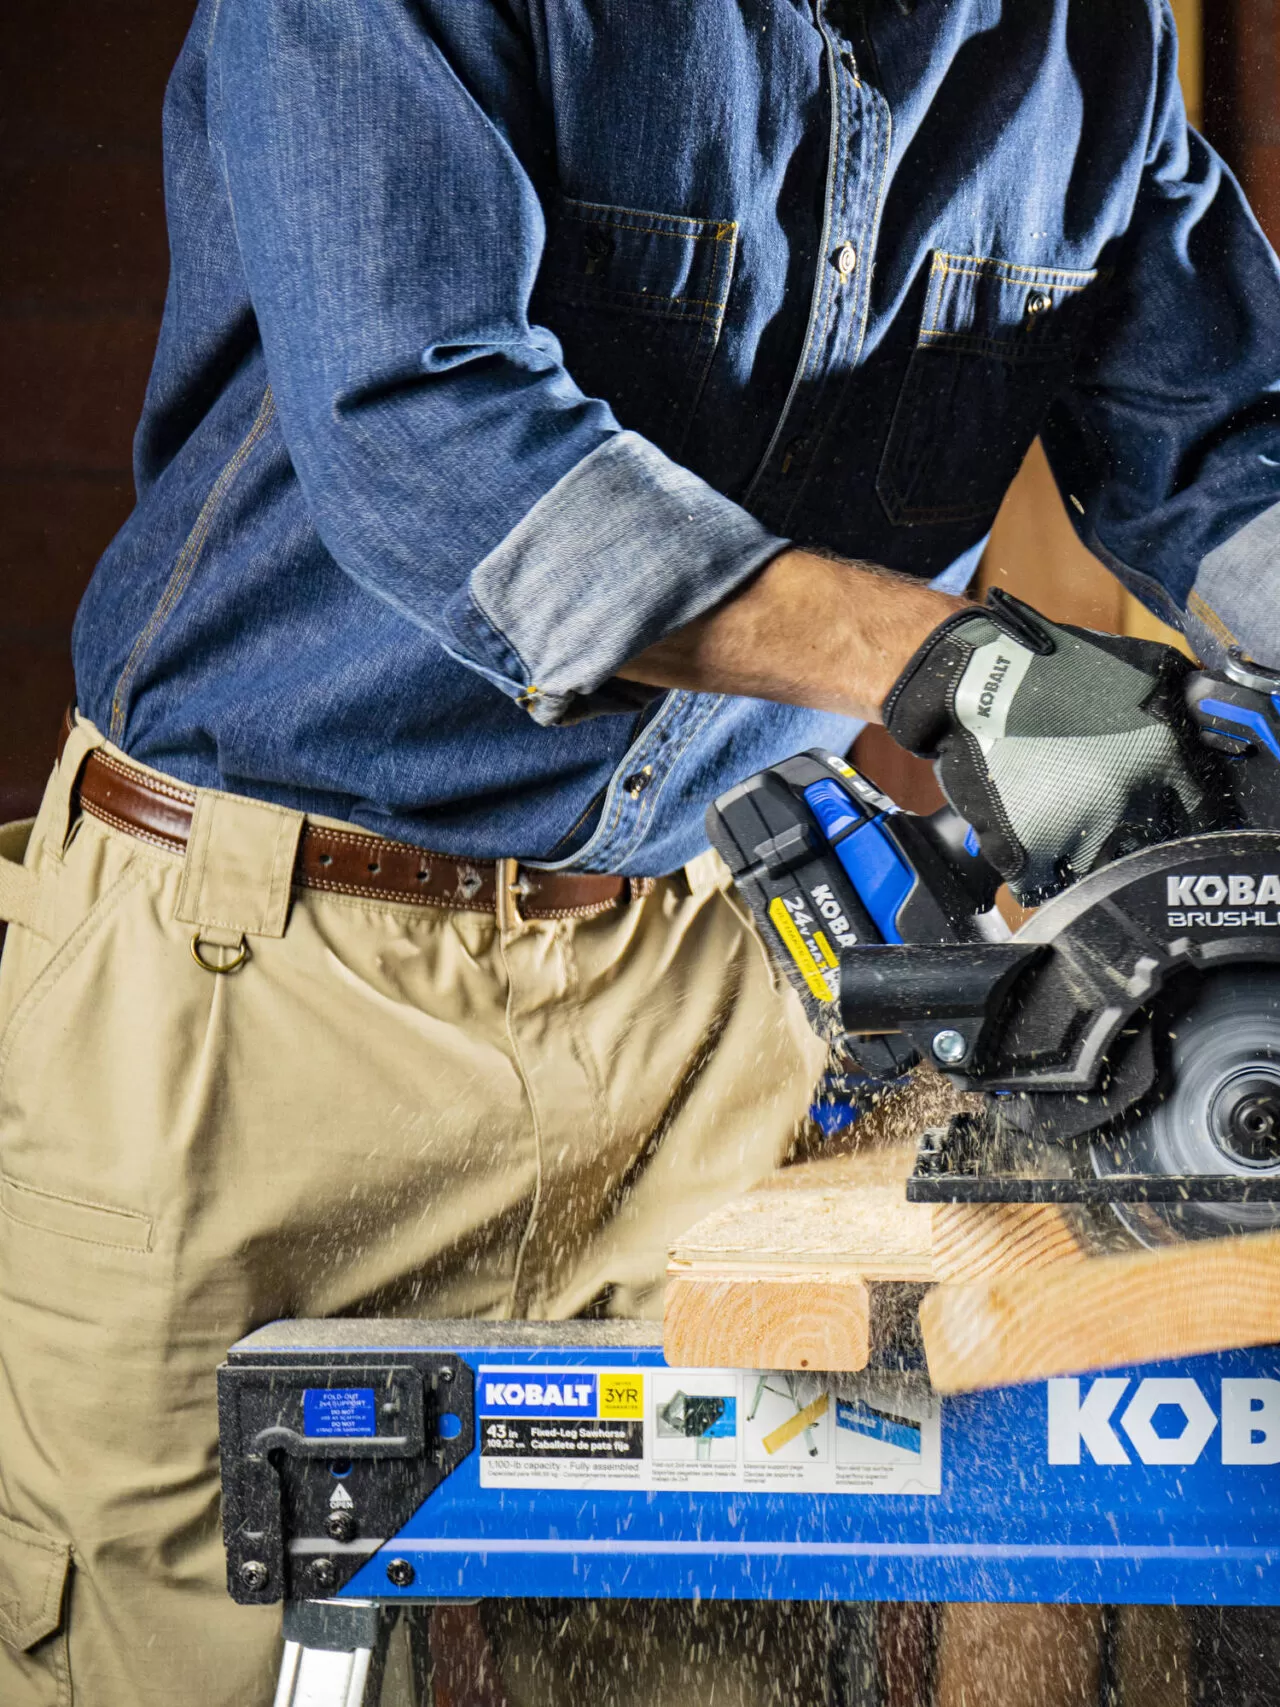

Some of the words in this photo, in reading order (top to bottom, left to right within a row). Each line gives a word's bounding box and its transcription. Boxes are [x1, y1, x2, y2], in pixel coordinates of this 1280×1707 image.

[977, 655, 1012, 718] KOBALT
[811, 884, 858, 947] KOBA
[485, 1383, 592, 1406] KOBALT
[605, 1388, 638, 1403] 3YR
[486, 1424, 507, 1439] 43
[508, 1429, 519, 1439] in
[531, 1427, 578, 1440] Fixed-Leg
[579, 1428, 626, 1439] Sawhorse
[530, 1440, 576, 1450] Caballete
[577, 1441, 589, 1450] de
[590, 1442, 612, 1451] pata
[614, 1441, 630, 1452] fija
[523, 1462, 560, 1472] capacity
[570, 1462, 590, 1472] Fully
[592, 1463, 639, 1471] assembled
[330, 1500, 354, 1509] OPEN
